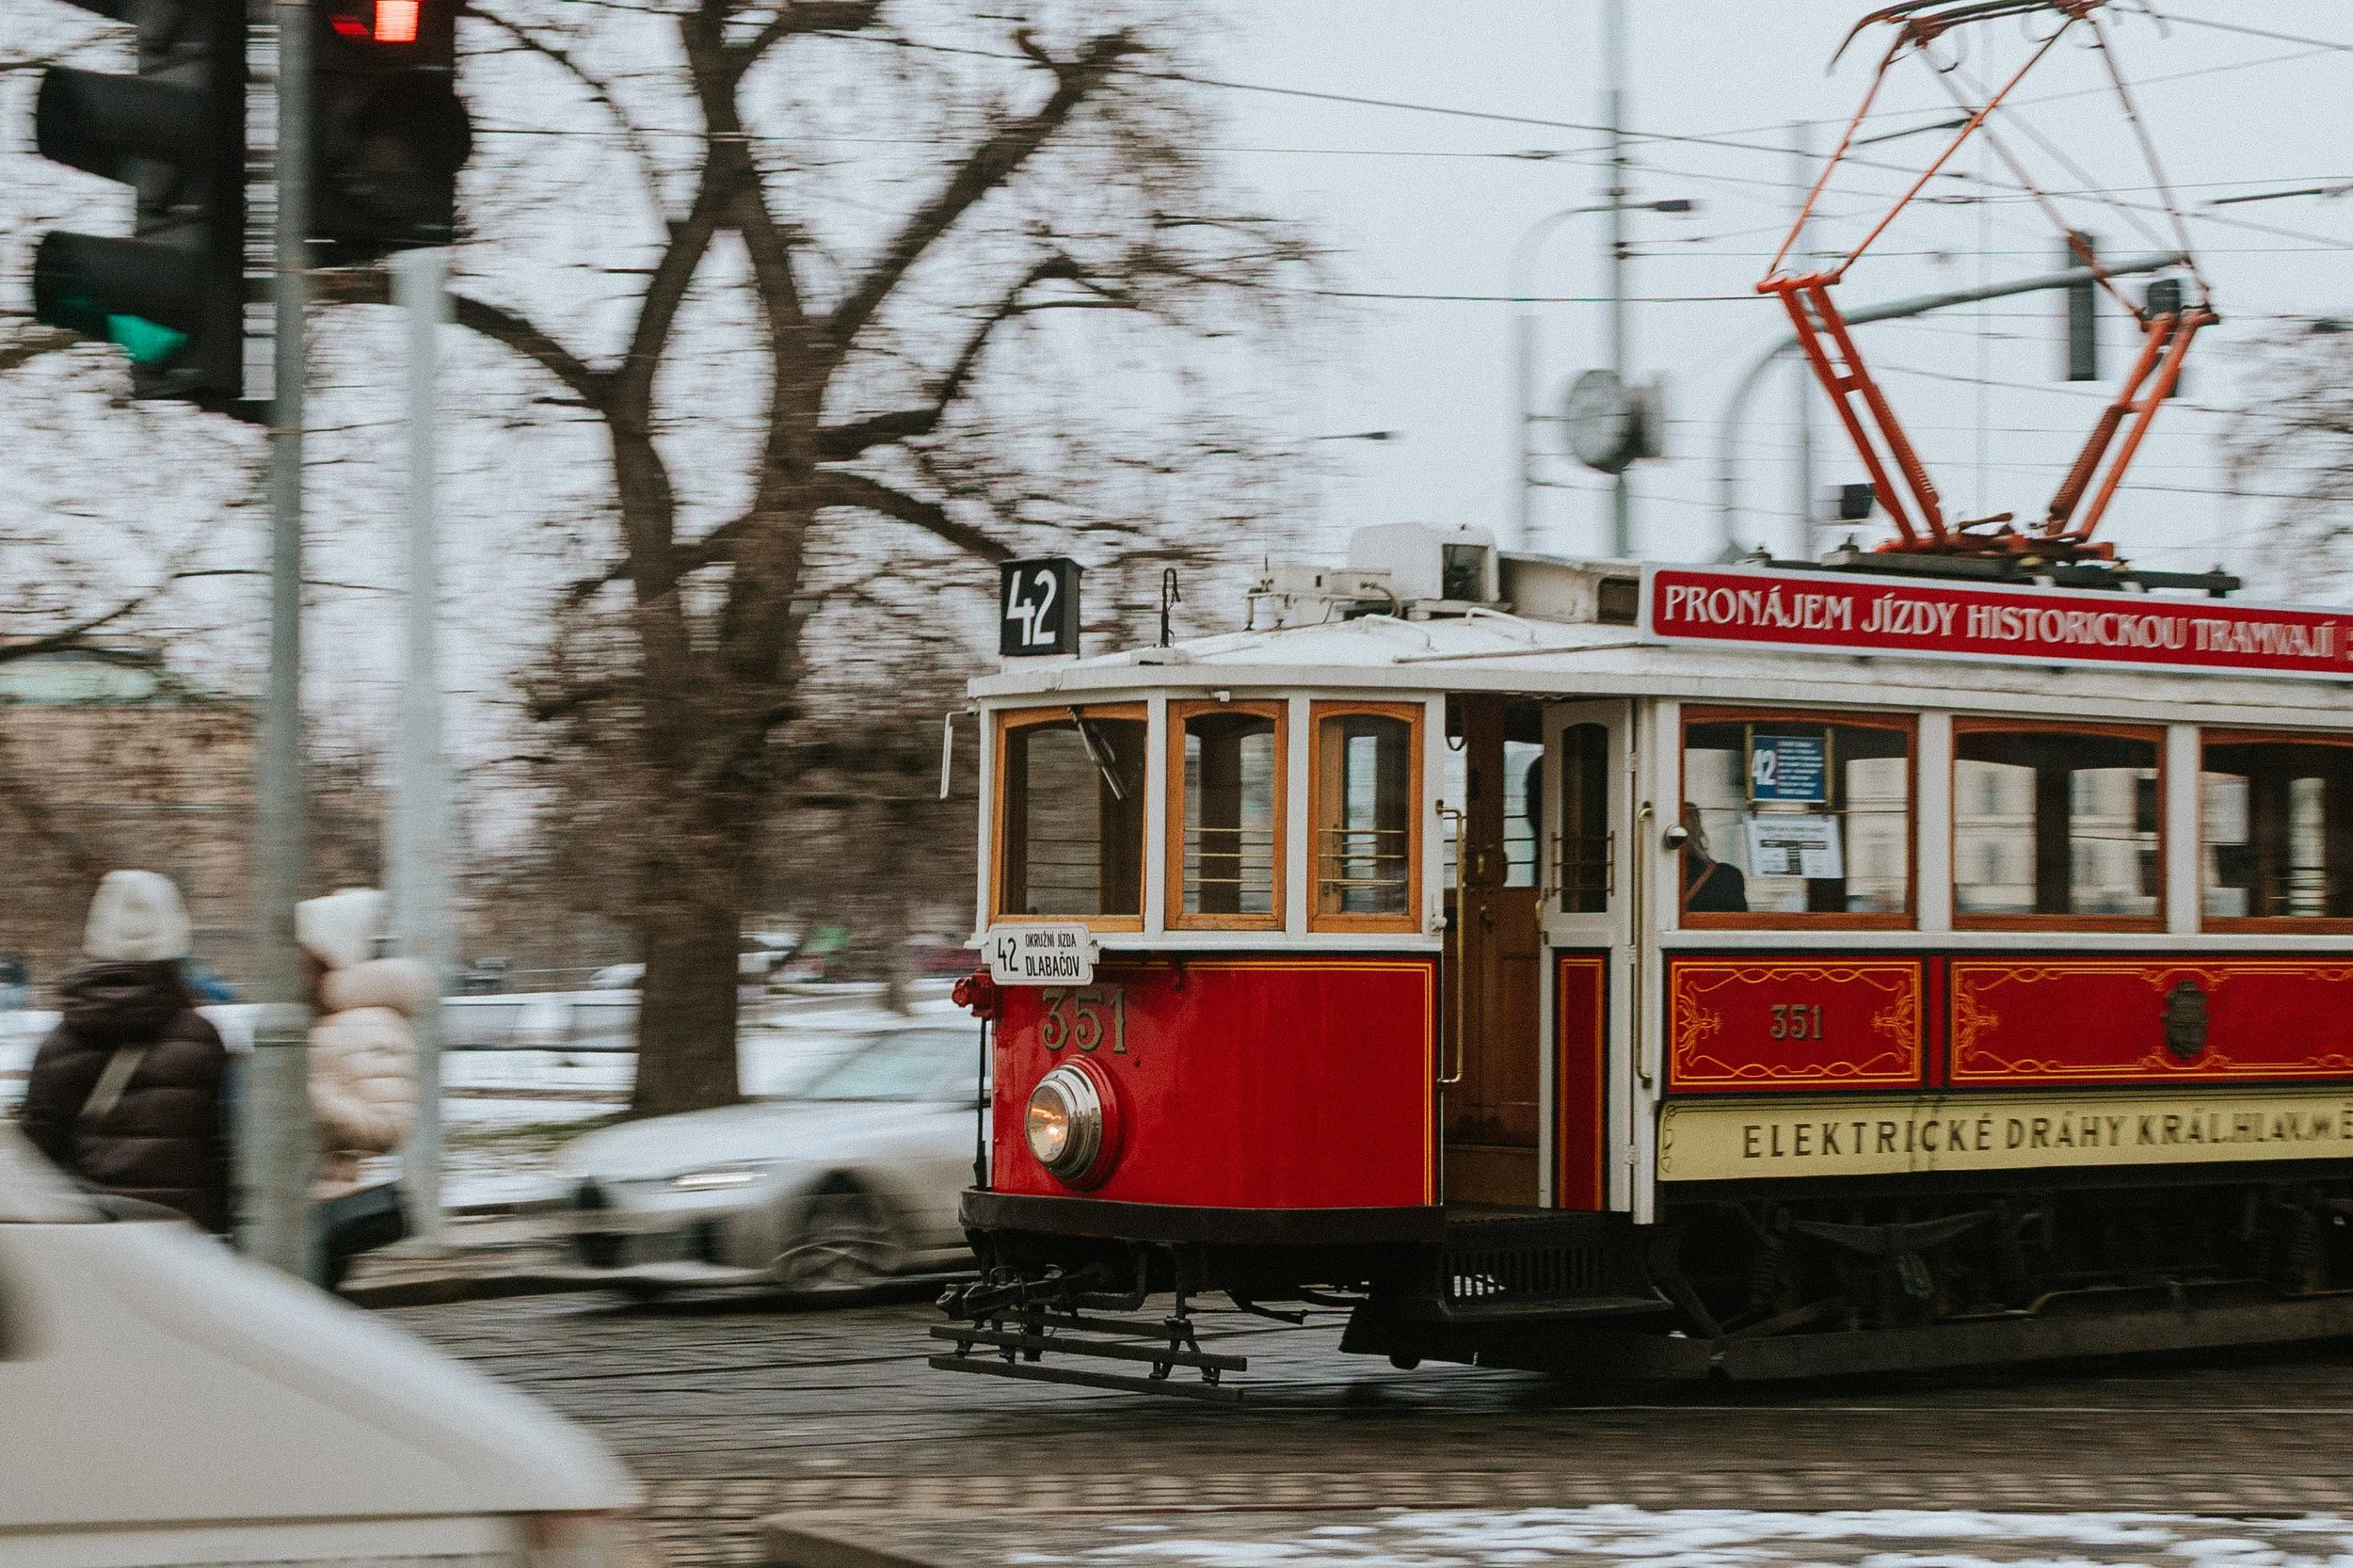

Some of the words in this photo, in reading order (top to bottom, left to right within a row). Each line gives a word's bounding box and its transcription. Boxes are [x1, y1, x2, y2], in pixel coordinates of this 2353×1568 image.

[1006, 569, 1057, 646] 42
[1664, 584, 1853, 631] PRONÁJEM
[1861, 591, 1960, 636] JÍZDY
[1966, 604, 2188, 649] HISTORICKOU
[2189, 619, 2336, 657] TRAMVAJÍ
[998, 937, 1018, 971] 42
[1025, 931, 1054, 948] OKRUŽNÍ
[1058, 931, 1076, 948] JÍZDA
[1026, 952, 1080, 977] DLABAČOV
[1043, 988, 1127, 1054] 351
[1770, 1004, 1823, 1041] 351
[1742, 1112, 1992, 1159] ELEKTRICKÉ
[2005, 1111, 2126, 1150] DRÁHY
